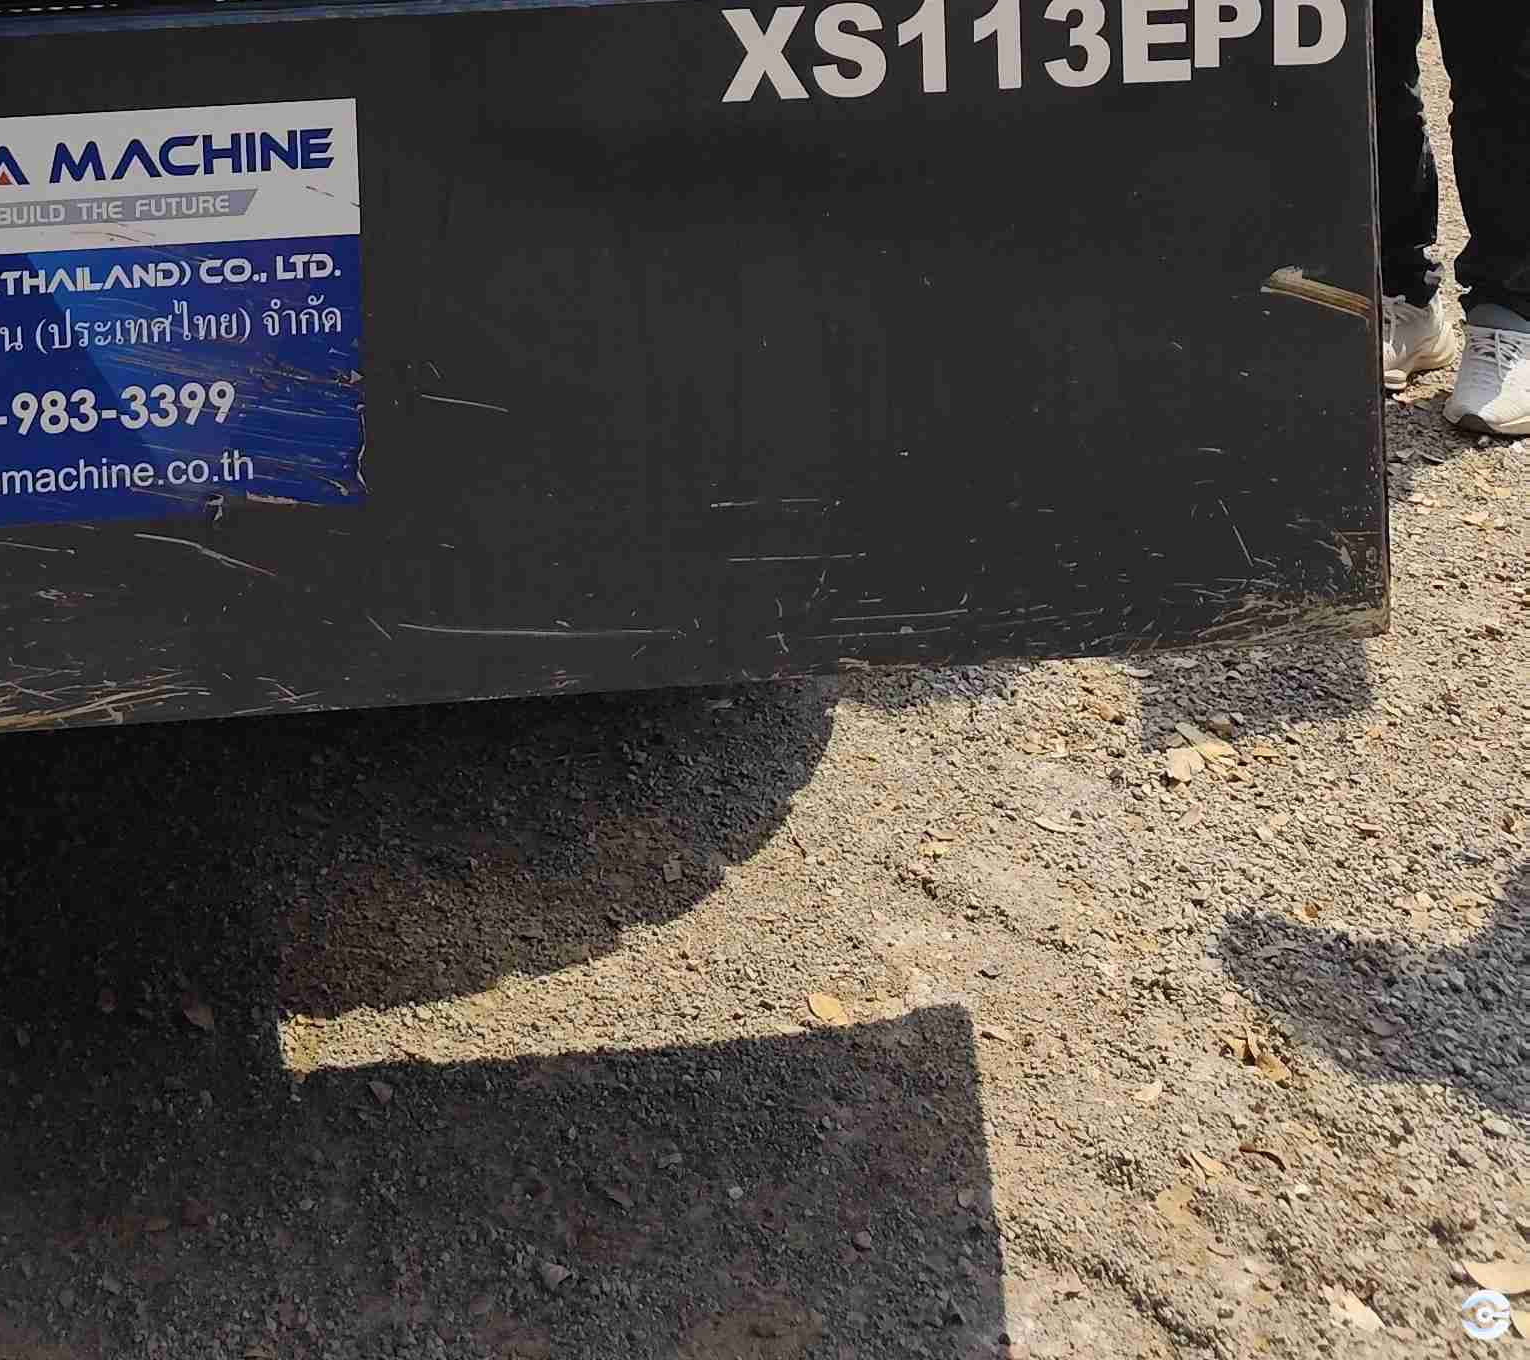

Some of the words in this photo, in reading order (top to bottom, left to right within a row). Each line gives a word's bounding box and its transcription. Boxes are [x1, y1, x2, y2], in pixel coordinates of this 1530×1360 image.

[48, 127, 336, 185] MACHINE
[77, 200, 123, 220] THE
[134, 194, 230, 217] FUTURE
[198, 257, 268, 284] CO.,
[275, 253, 342, 280] LTD.
[34, 298, 252, 355] (ประเทศไทย)
[261, 294, 343, 338] จำกัด
